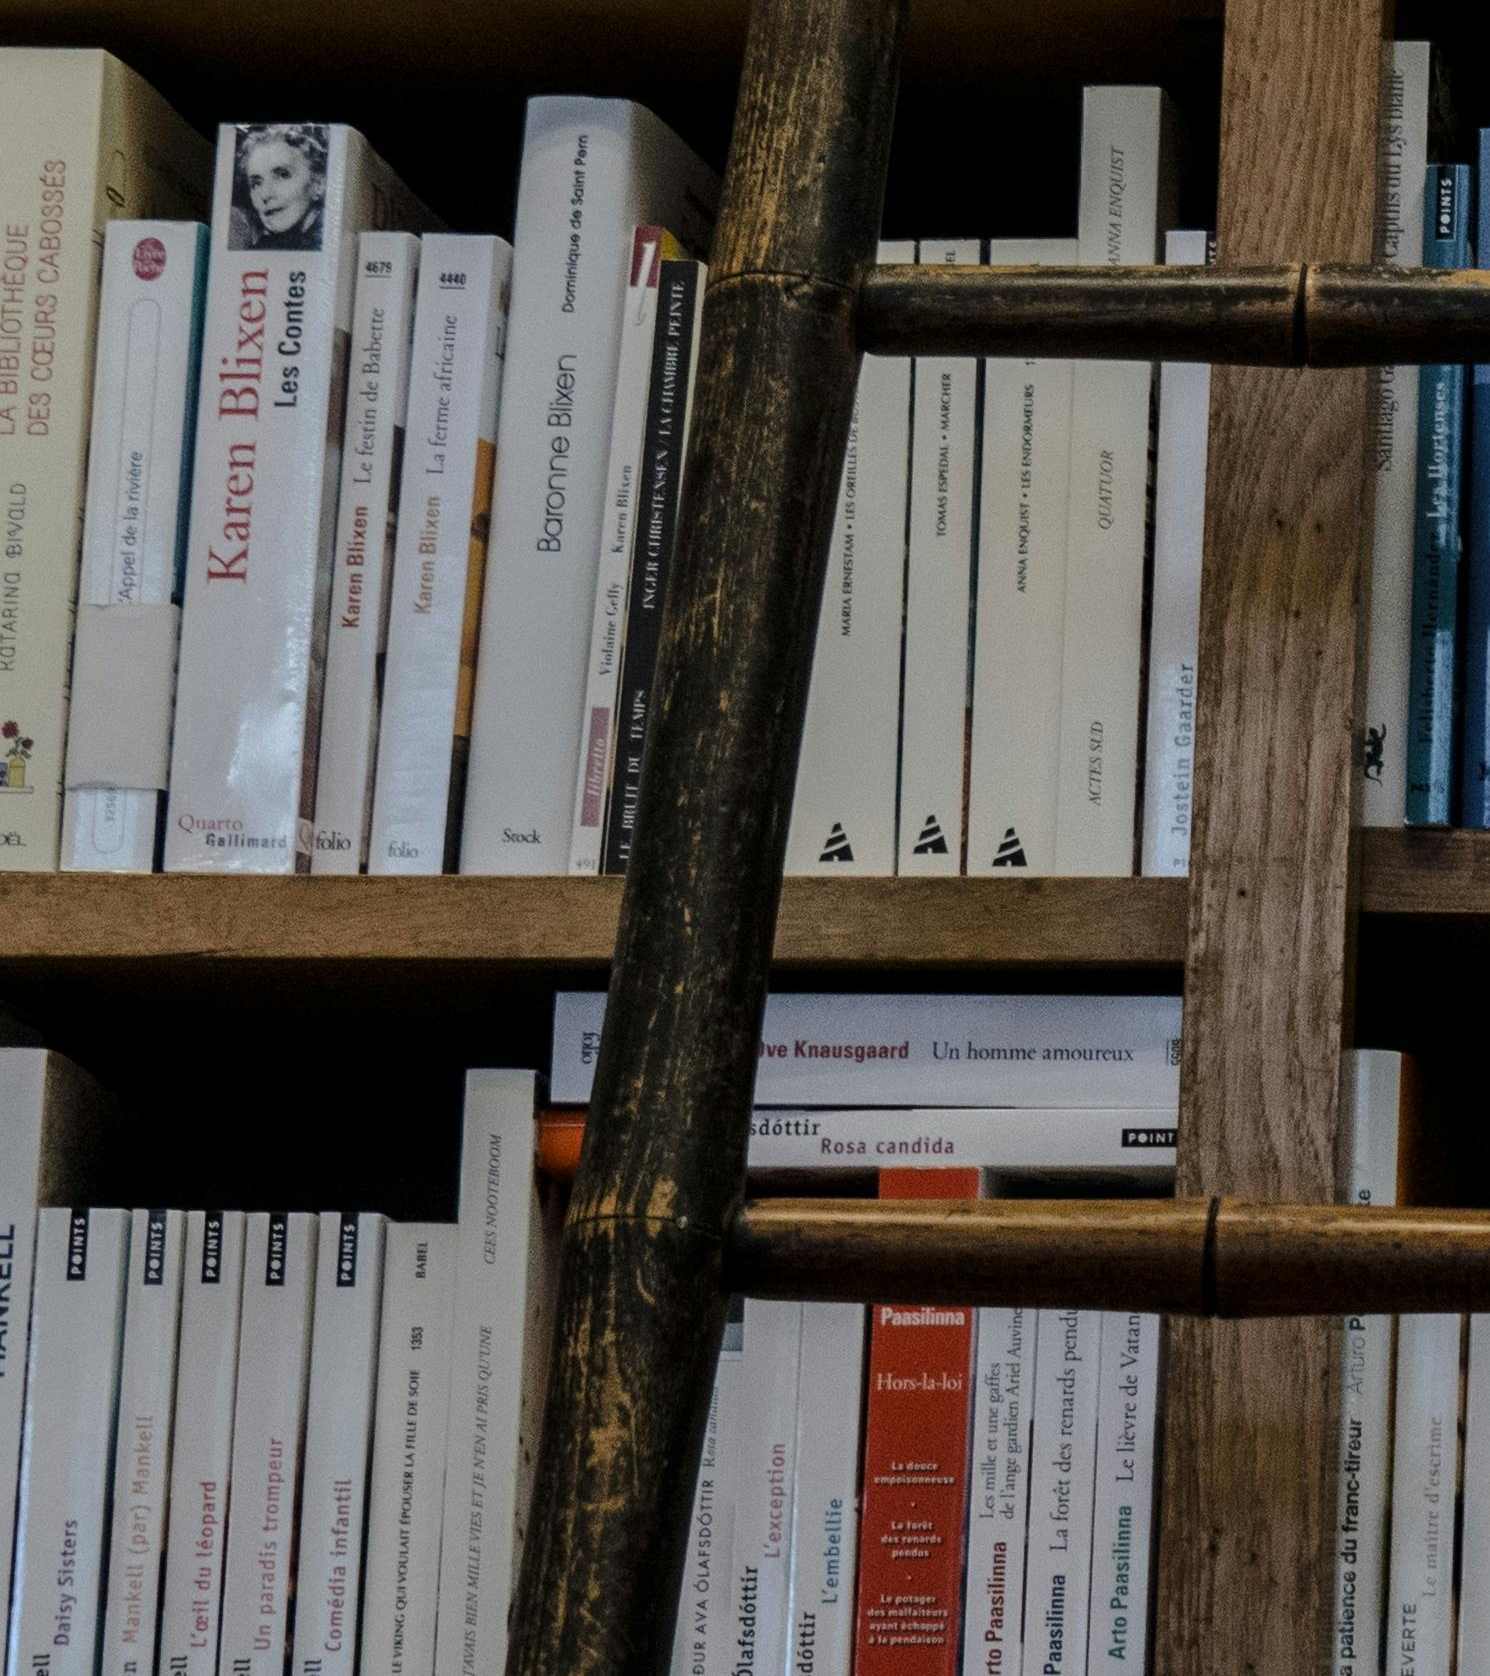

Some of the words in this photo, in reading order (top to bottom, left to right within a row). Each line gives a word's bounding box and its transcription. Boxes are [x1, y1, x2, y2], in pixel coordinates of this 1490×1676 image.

[34, 158, 68, 285] CABOSSÉS
[28, 292, 59, 383] CŒURS
[275, 269, 307, 357] Contes
[359, 307, 385, 375] Babette
[217, 269, 270, 419] Blixen
[25, 390, 53, 437] DES
[272, 364, 301, 409] Les
[357, 380, 379, 403] de
[545, 353, 578, 428] Blixen
[0, 406, 15, 435] LA
[352, 407, 378, 457] festin
[351, 461, 374, 485] Le
[534, 434, 571, 553] Baronne
[205, 442, 257, 583] Karen
[344, 504, 369, 568] Blixen
[339, 571, 364, 629] Karen
[931, 1039, 961, 1061] Un
[965, 1039, 1038, 1061] homme
[1040, 1046, 1134, 1062] amoureux
[819, 1136, 867, 1156] Rosa
[874, 1135, 955, 1156] candida
[55, 1518, 79, 1588] Sisters
[51, 1592, 78, 1647] Daisy
